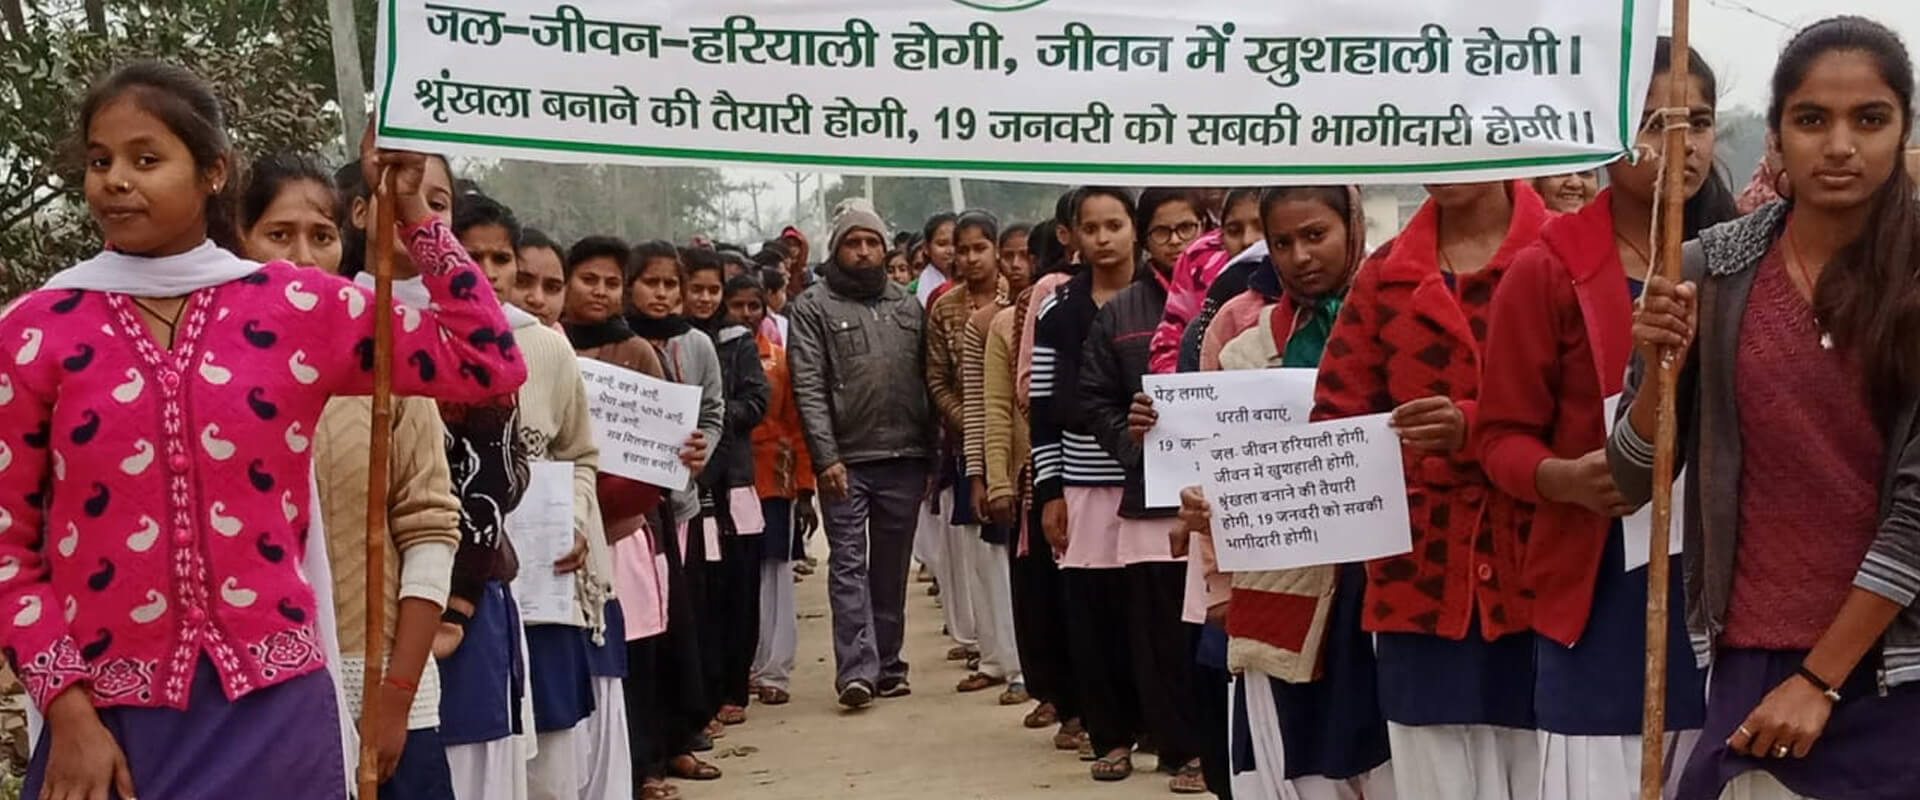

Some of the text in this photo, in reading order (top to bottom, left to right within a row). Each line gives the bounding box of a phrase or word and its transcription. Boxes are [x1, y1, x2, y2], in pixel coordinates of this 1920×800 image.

[425, 3, 879, 71] जल-जीवन-हरियाली
[892, 22, 1018, 75] होगी,
[1035, 22, 1174, 73] जीवन
[1185, 21, 1236, 73] में
[1243, 23, 1453, 87] खुशहाली
[540, 85, 640, 126] बनाने
[649, 87, 702, 130] की
[709, 89, 814, 135] तैयारी
[823, 96, 919, 144] होगी,
[934, 106, 976, 141] 19
[988, 101, 1114, 144] जनवरी
[1123, 103, 1178, 145] को
[1186, 102, 1301, 146] सबकी
[1311, 103, 1473, 147] भागीदारी
[1154, 385, 1174, 402] पेड़
[1216, 406, 1249, 423] धरती
[1159, 439, 1173, 451] 19
[1241, 441, 1277, 457] जीवन
[1280, 431, 1332, 454] हरियाली
[1335, 427, 1369, 446] होगी,
[1214, 450, 1359, 483] जीवन में खुशहाली होगी,
[1259, 484, 1295, 502] बनाने
[1298, 480, 1316, 497] की
[1319, 476, 1356, 495] तैयारी
[1221, 494, 1383, 529] होगी, 19 जनवरी को सबकी
[1226, 530, 1281, 550] भागीदारी
